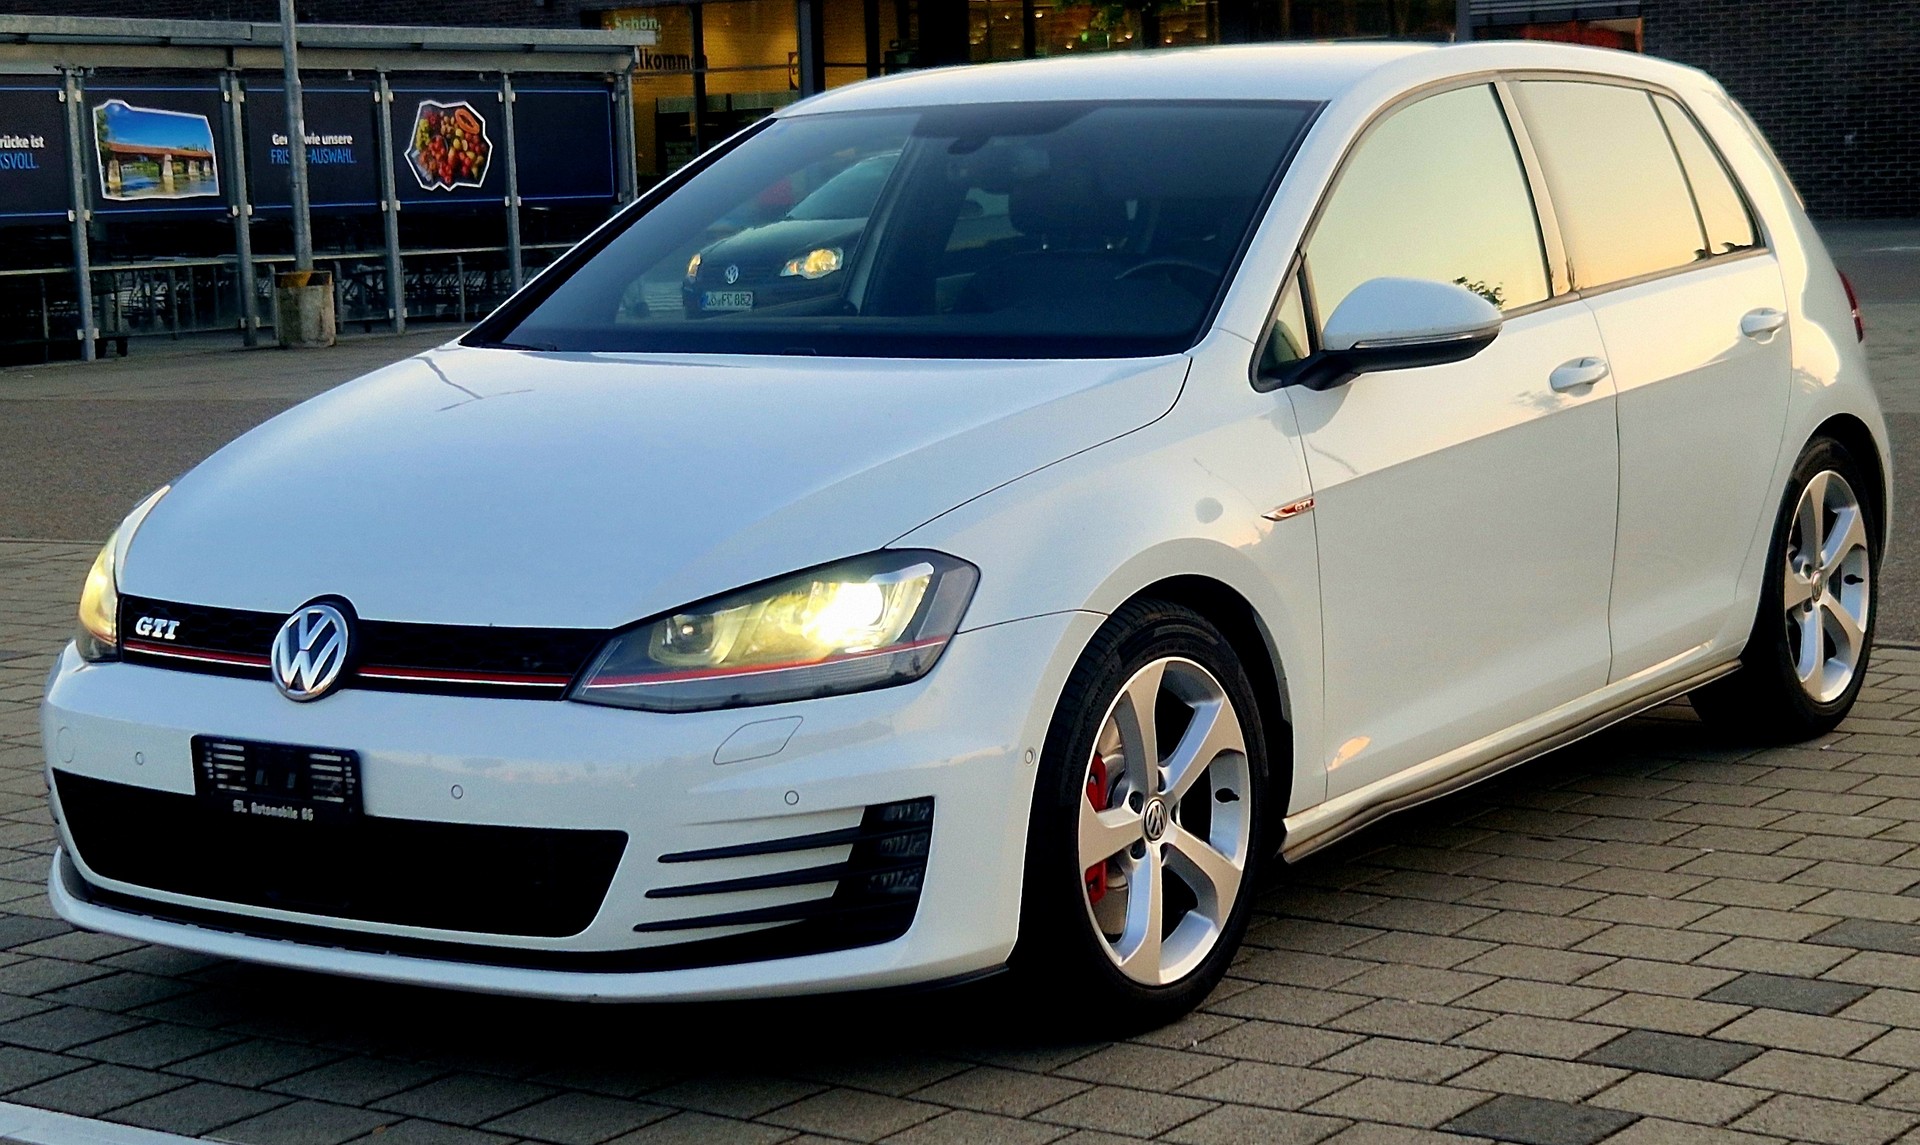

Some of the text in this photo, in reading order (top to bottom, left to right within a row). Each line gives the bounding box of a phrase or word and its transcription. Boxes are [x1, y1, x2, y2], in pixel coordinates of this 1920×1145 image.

[30, 134, 45, 149] ist
[321, 134, 353, 145] unsere
[135, 616, 180, 640] GTI
